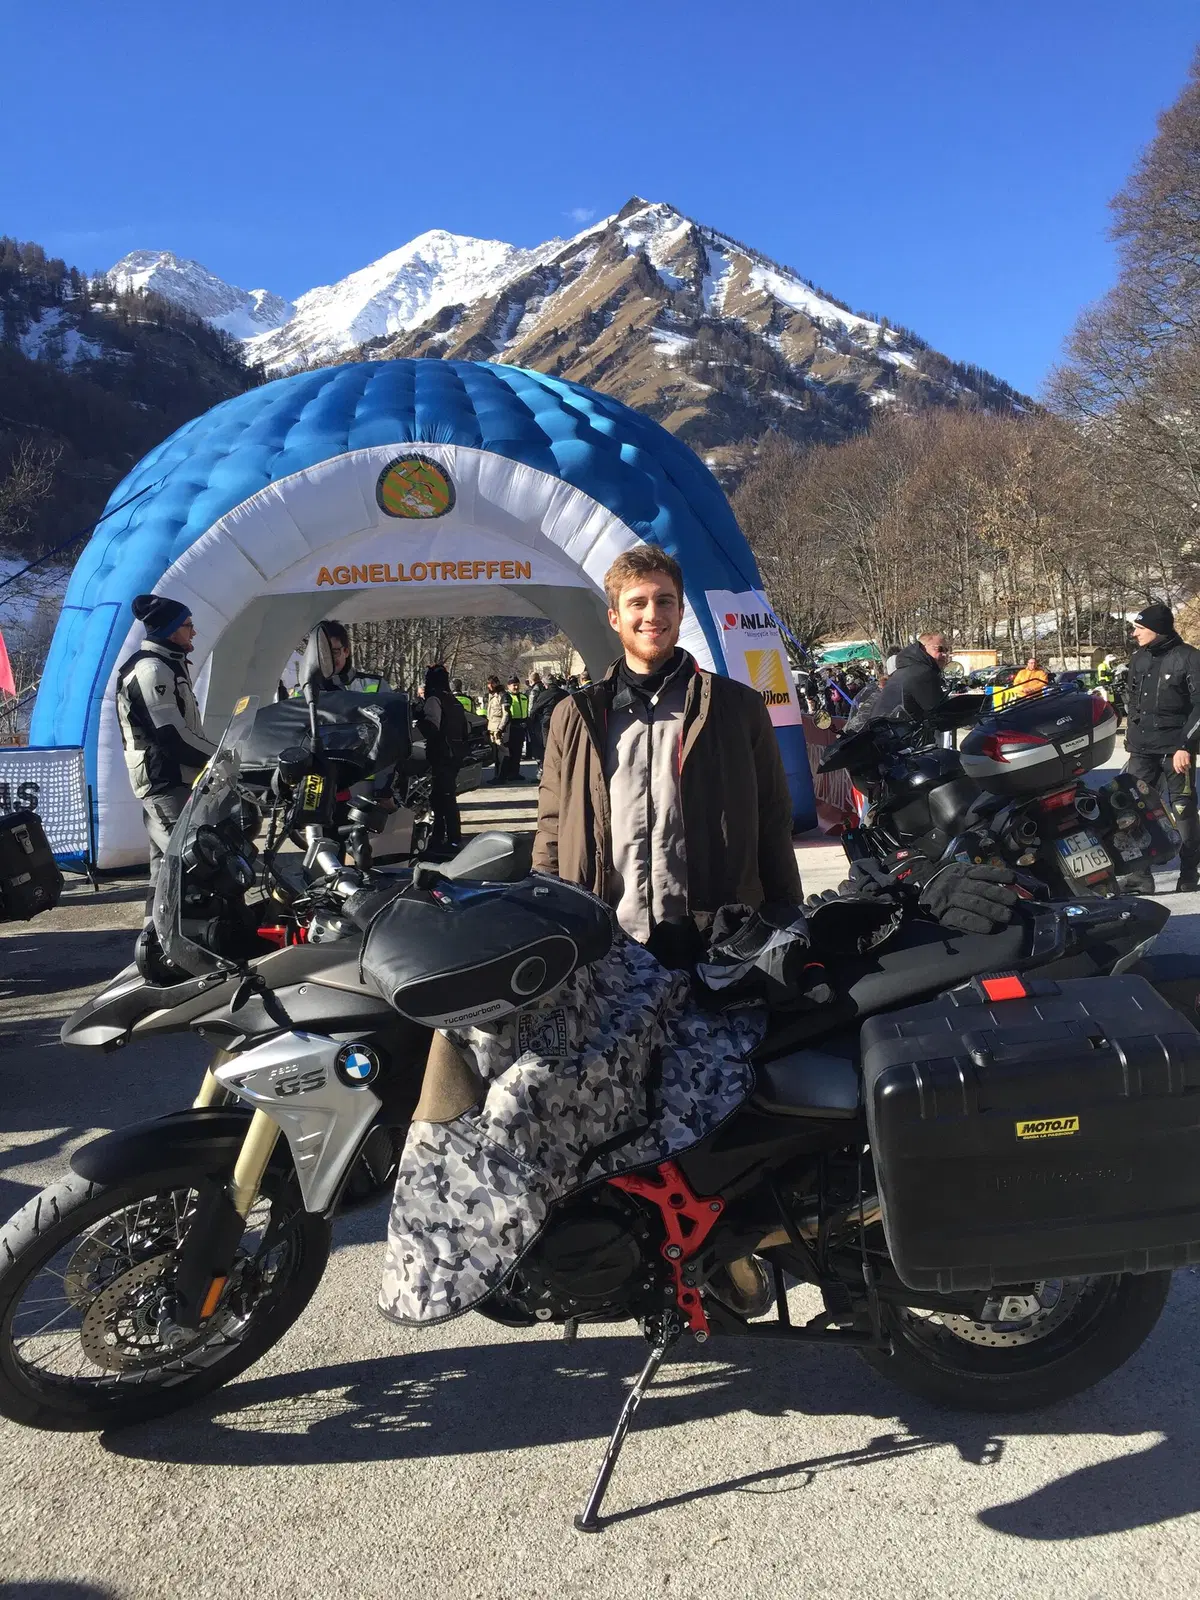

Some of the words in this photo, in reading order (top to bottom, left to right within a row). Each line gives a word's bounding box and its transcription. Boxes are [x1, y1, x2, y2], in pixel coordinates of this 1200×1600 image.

[316, 560, 532, 586] AGNELLOTREFFEN
[1066, 835, 1082, 852] CF
[1072, 848, 1108, 873] 47169
[339, 1046, 371, 1062] BMW
[274, 1067, 327, 1098] GS
[1022, 1119, 1076, 1134] MOTO.IT
